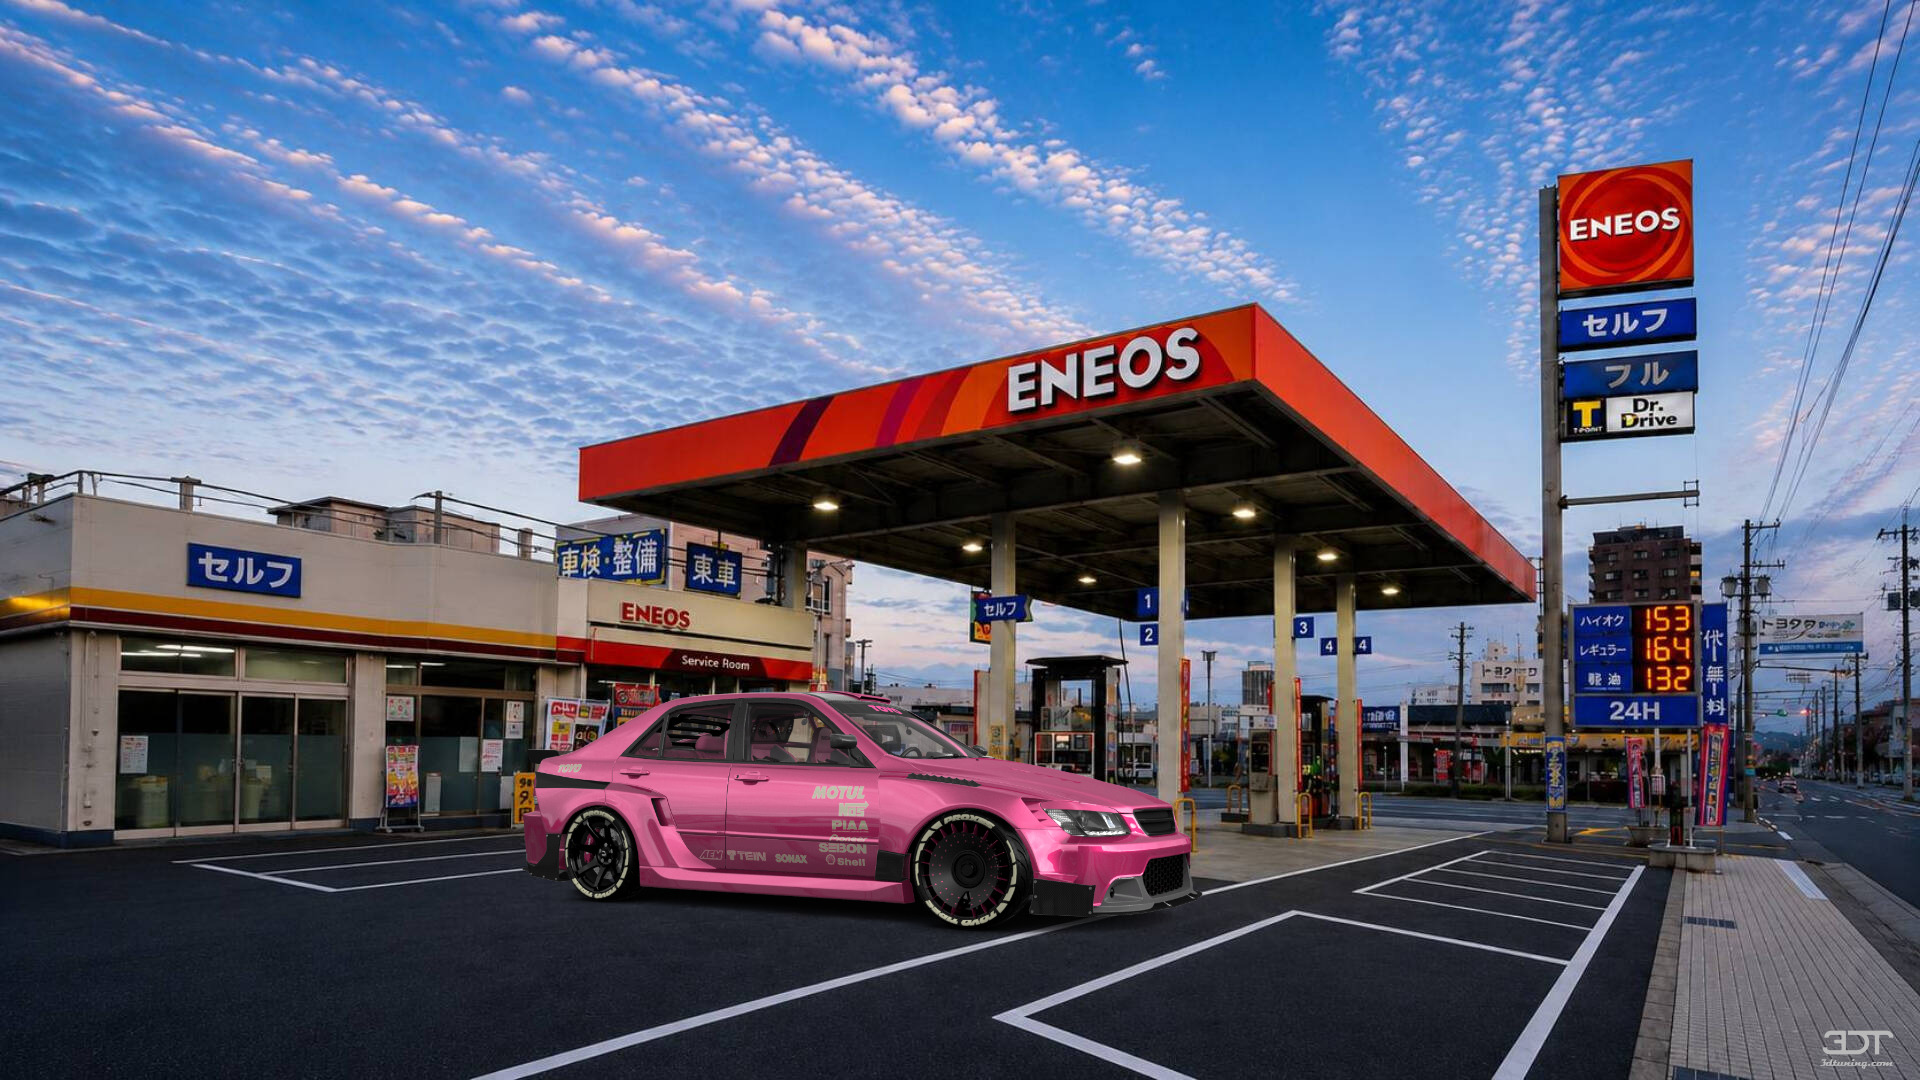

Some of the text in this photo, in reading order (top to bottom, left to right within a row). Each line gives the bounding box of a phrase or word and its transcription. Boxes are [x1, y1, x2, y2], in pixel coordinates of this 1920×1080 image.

[1570, 207, 1680, 241] ENEOS
[1583, 308, 1668, 337] セルフ
[1008, 327, 1200, 412] ENEOS
[1605, 361, 1668, 389] フル
[1633, 398, 1663, 412] Dr.
[1573, 400, 1601, 427] T
[1621, 413, 1677, 428] Drive
[561, 538, 658, 577] 車検・整備
[198, 552, 293, 588] セルフ
[1144, 594, 1151, 608] 1
[621, 602, 691, 629] ENEOS
[984, 602, 1016, 617] セルフ
[1580, 614, 1625, 628] ハイオク
[1645, 605, 1690, 632] 153
[1145, 628, 1154, 642] 2
[1299, 621, 1308, 635] 3
[1325, 640, 1333, 653] 4
[1358, 639, 1367, 650] 4
[1580, 644, 1627, 656] レギュラー
[1645, 636, 1690, 662] 164
[682, 655, 750, 671] Service Room
[1647, 666, 1690, 691] 132
[1610, 701, 1661, 720] 24H
[558, 764, 582, 773] TOYO
[812, 786, 865, 799] MOTUL
[838, 801, 868, 817] NOS
[832, 820, 869, 831] PIAA
[700, 850, 723, 860] AEM
[737, 851, 766, 861] TEIN
[775, 853, 807, 864] SONAX
[837, 857, 866, 867] Shell
